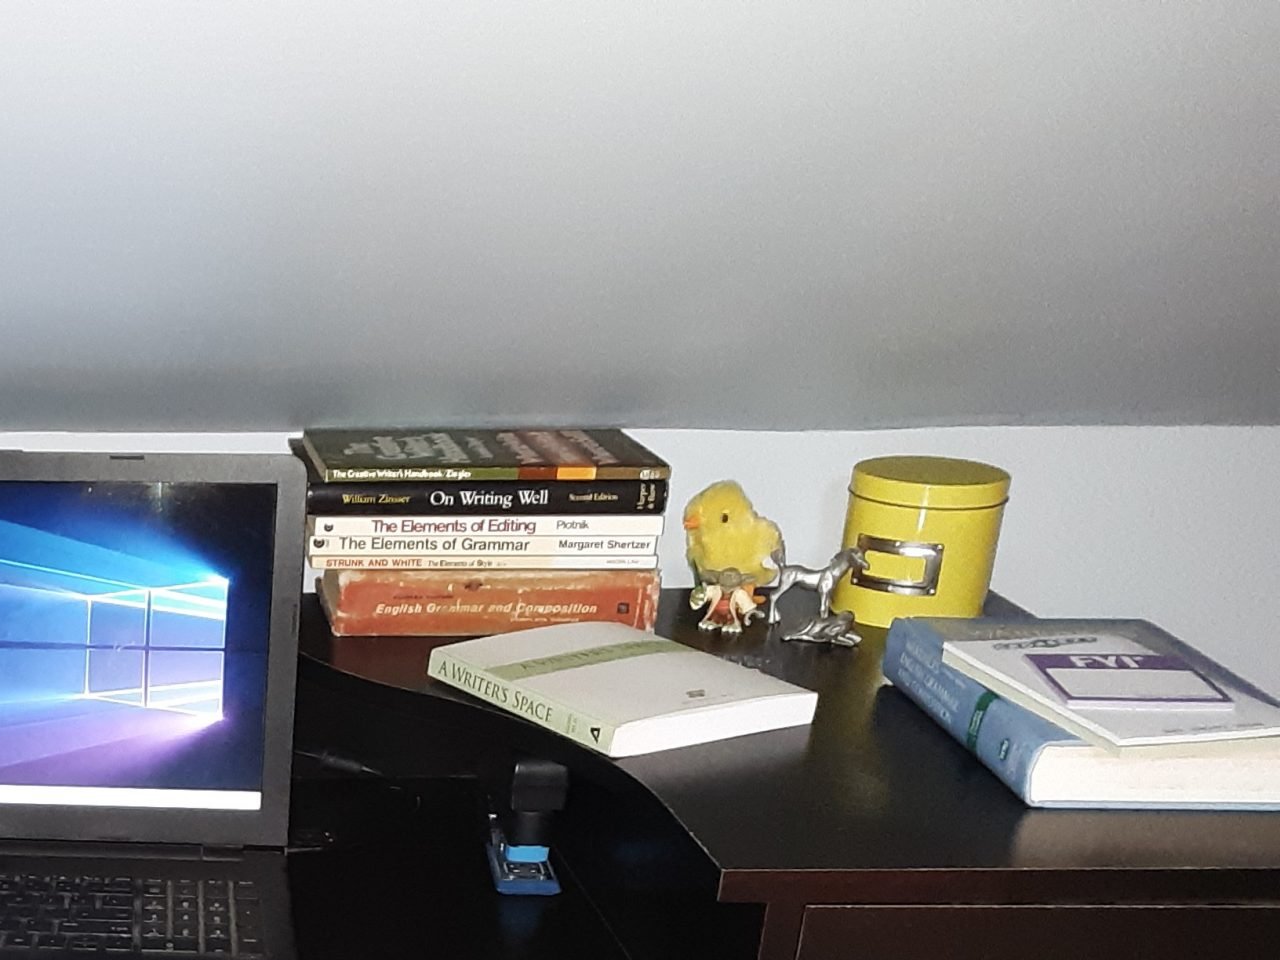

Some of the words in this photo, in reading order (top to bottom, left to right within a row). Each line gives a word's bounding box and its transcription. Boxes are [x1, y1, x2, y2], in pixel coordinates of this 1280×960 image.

[333, 469, 346, 478] The
[342, 494, 376, 504] William
[430, 490, 454, 506] On
[459, 489, 513, 509] Writing
[518, 489, 549, 505] Well
[594, 493, 619, 501] Edition
[372, 519, 397, 533] The
[401, 519, 467, 533] Elements
[470, 519, 486, 532] of
[488, 518, 537, 535] Editing
[556, 519, 590, 531] Plotnik
[339, 536, 367, 550] The
[371, 537, 438, 550] Elements
[442, 537, 457, 550] of
[461, 538, 530, 551] Grammar
[558, 539, 604, 550] Margaret
[607, 539, 651, 549] Shertzer
[326, 558, 364, 567] STRUNK
[368, 558, 389, 567] AND
[392, 558, 423, 567] WHITE
[376, 602, 422, 615] English
[488, 602, 513, 613] and
[516, 602, 598, 615] Composition
[438, 660, 448, 675] A
[451, 663, 509, 703] WRITER'S
[511, 691, 554, 723] SPACE
